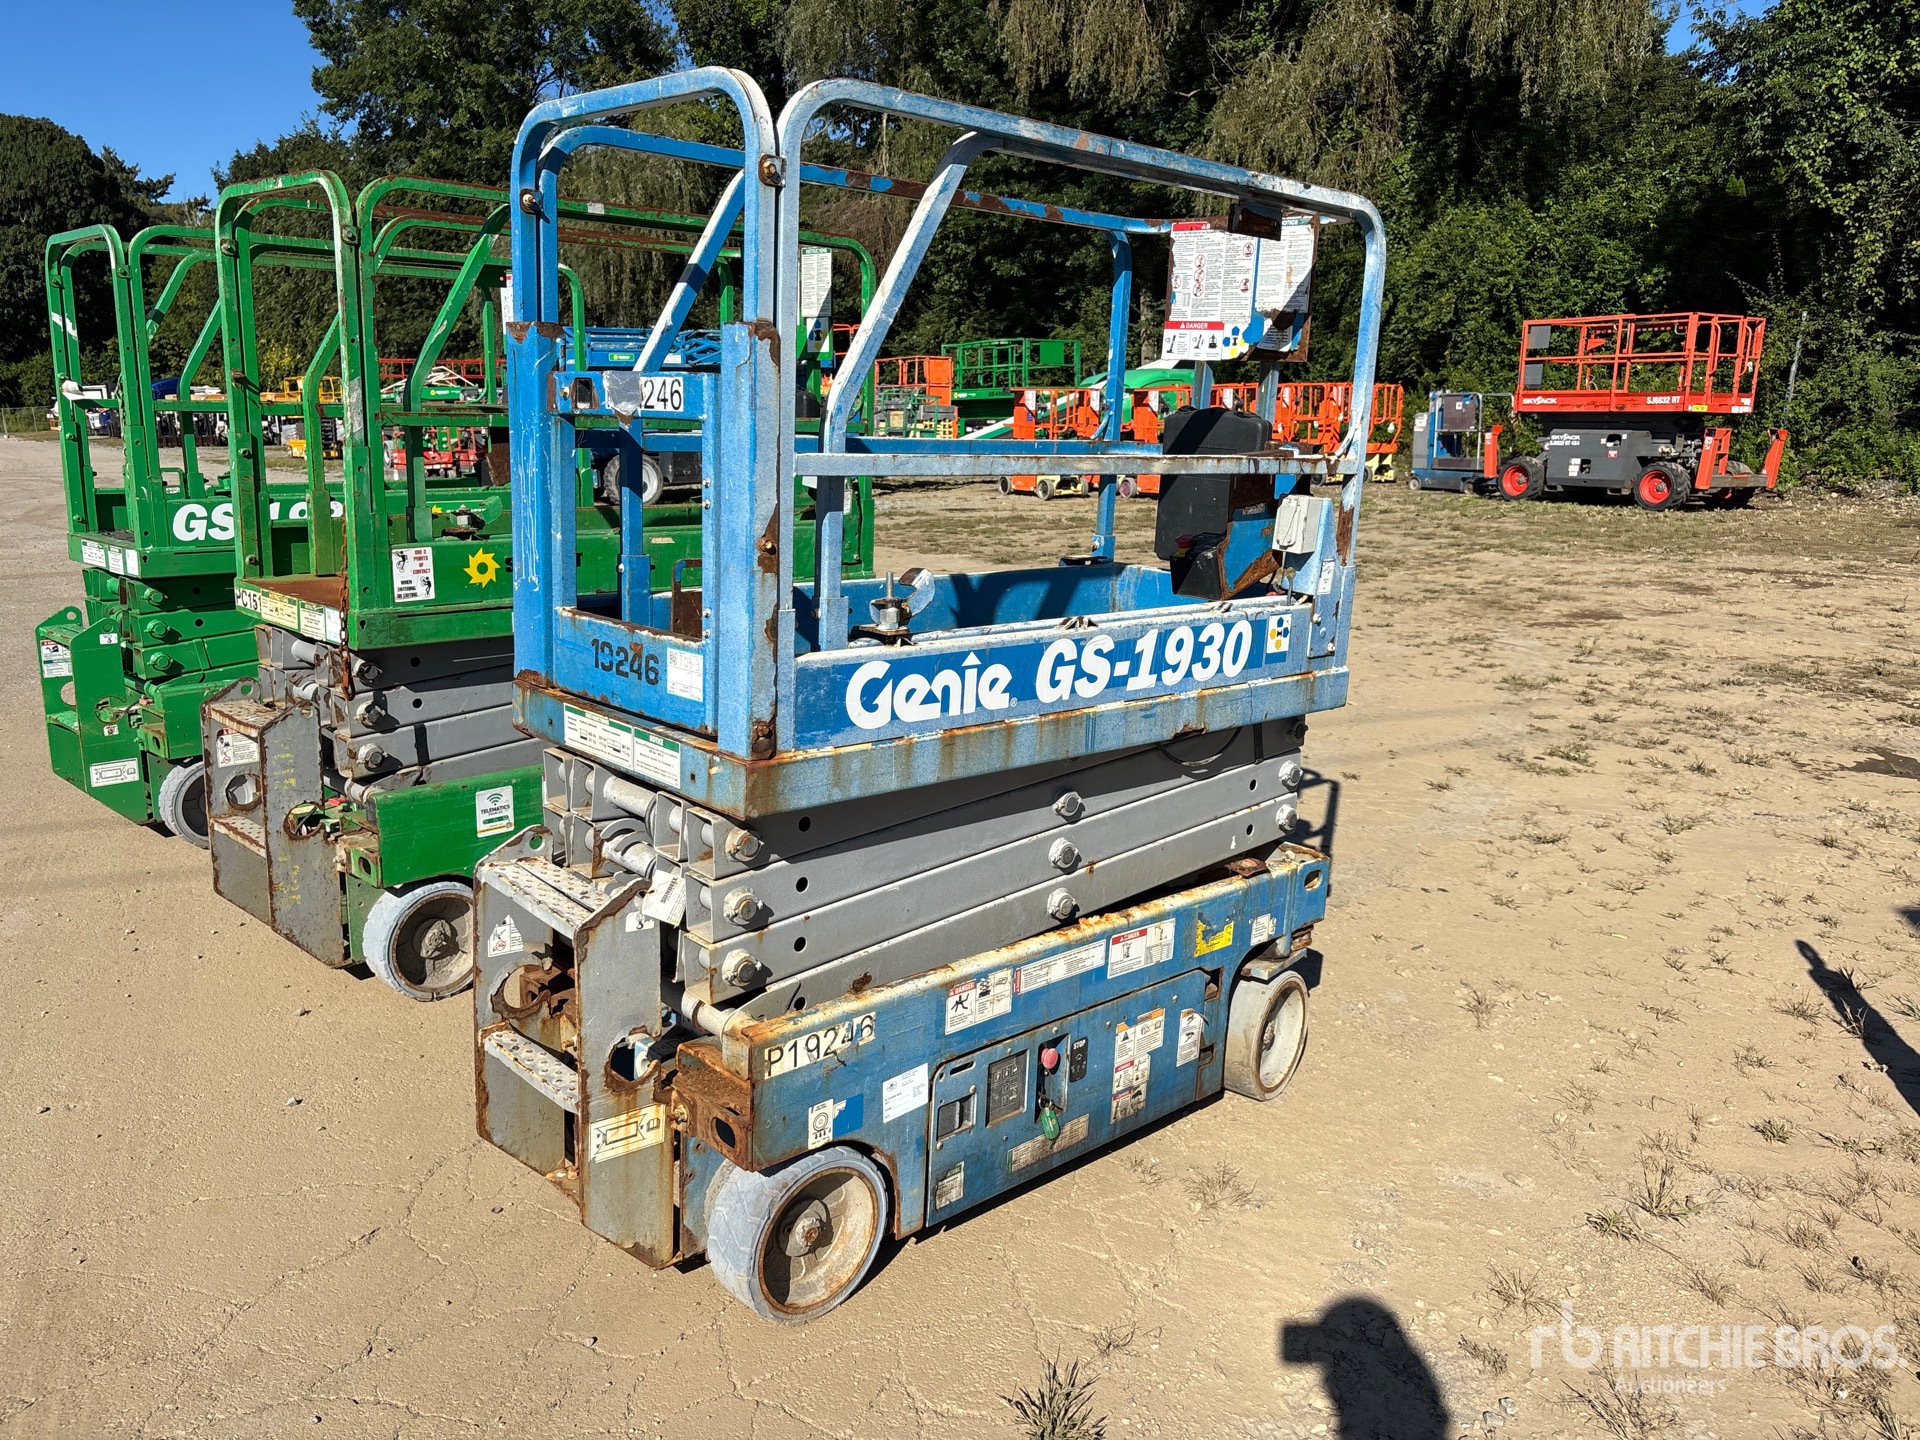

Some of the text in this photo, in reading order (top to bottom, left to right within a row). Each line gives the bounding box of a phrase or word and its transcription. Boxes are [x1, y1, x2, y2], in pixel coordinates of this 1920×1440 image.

[640, 378, 682, 411] 246
[1671, 396, 1681, 404] RT
[1522, 396, 1557, 405] SKYJACK
[1550, 433, 1581, 441] SKYJACK
[591, 638, 660, 686] 19246
[1036, 619, 1253, 704] GS-1930
[480, 804, 511, 815] TELEMATICS
[1073, 1039, 1086, 1050] STOP
